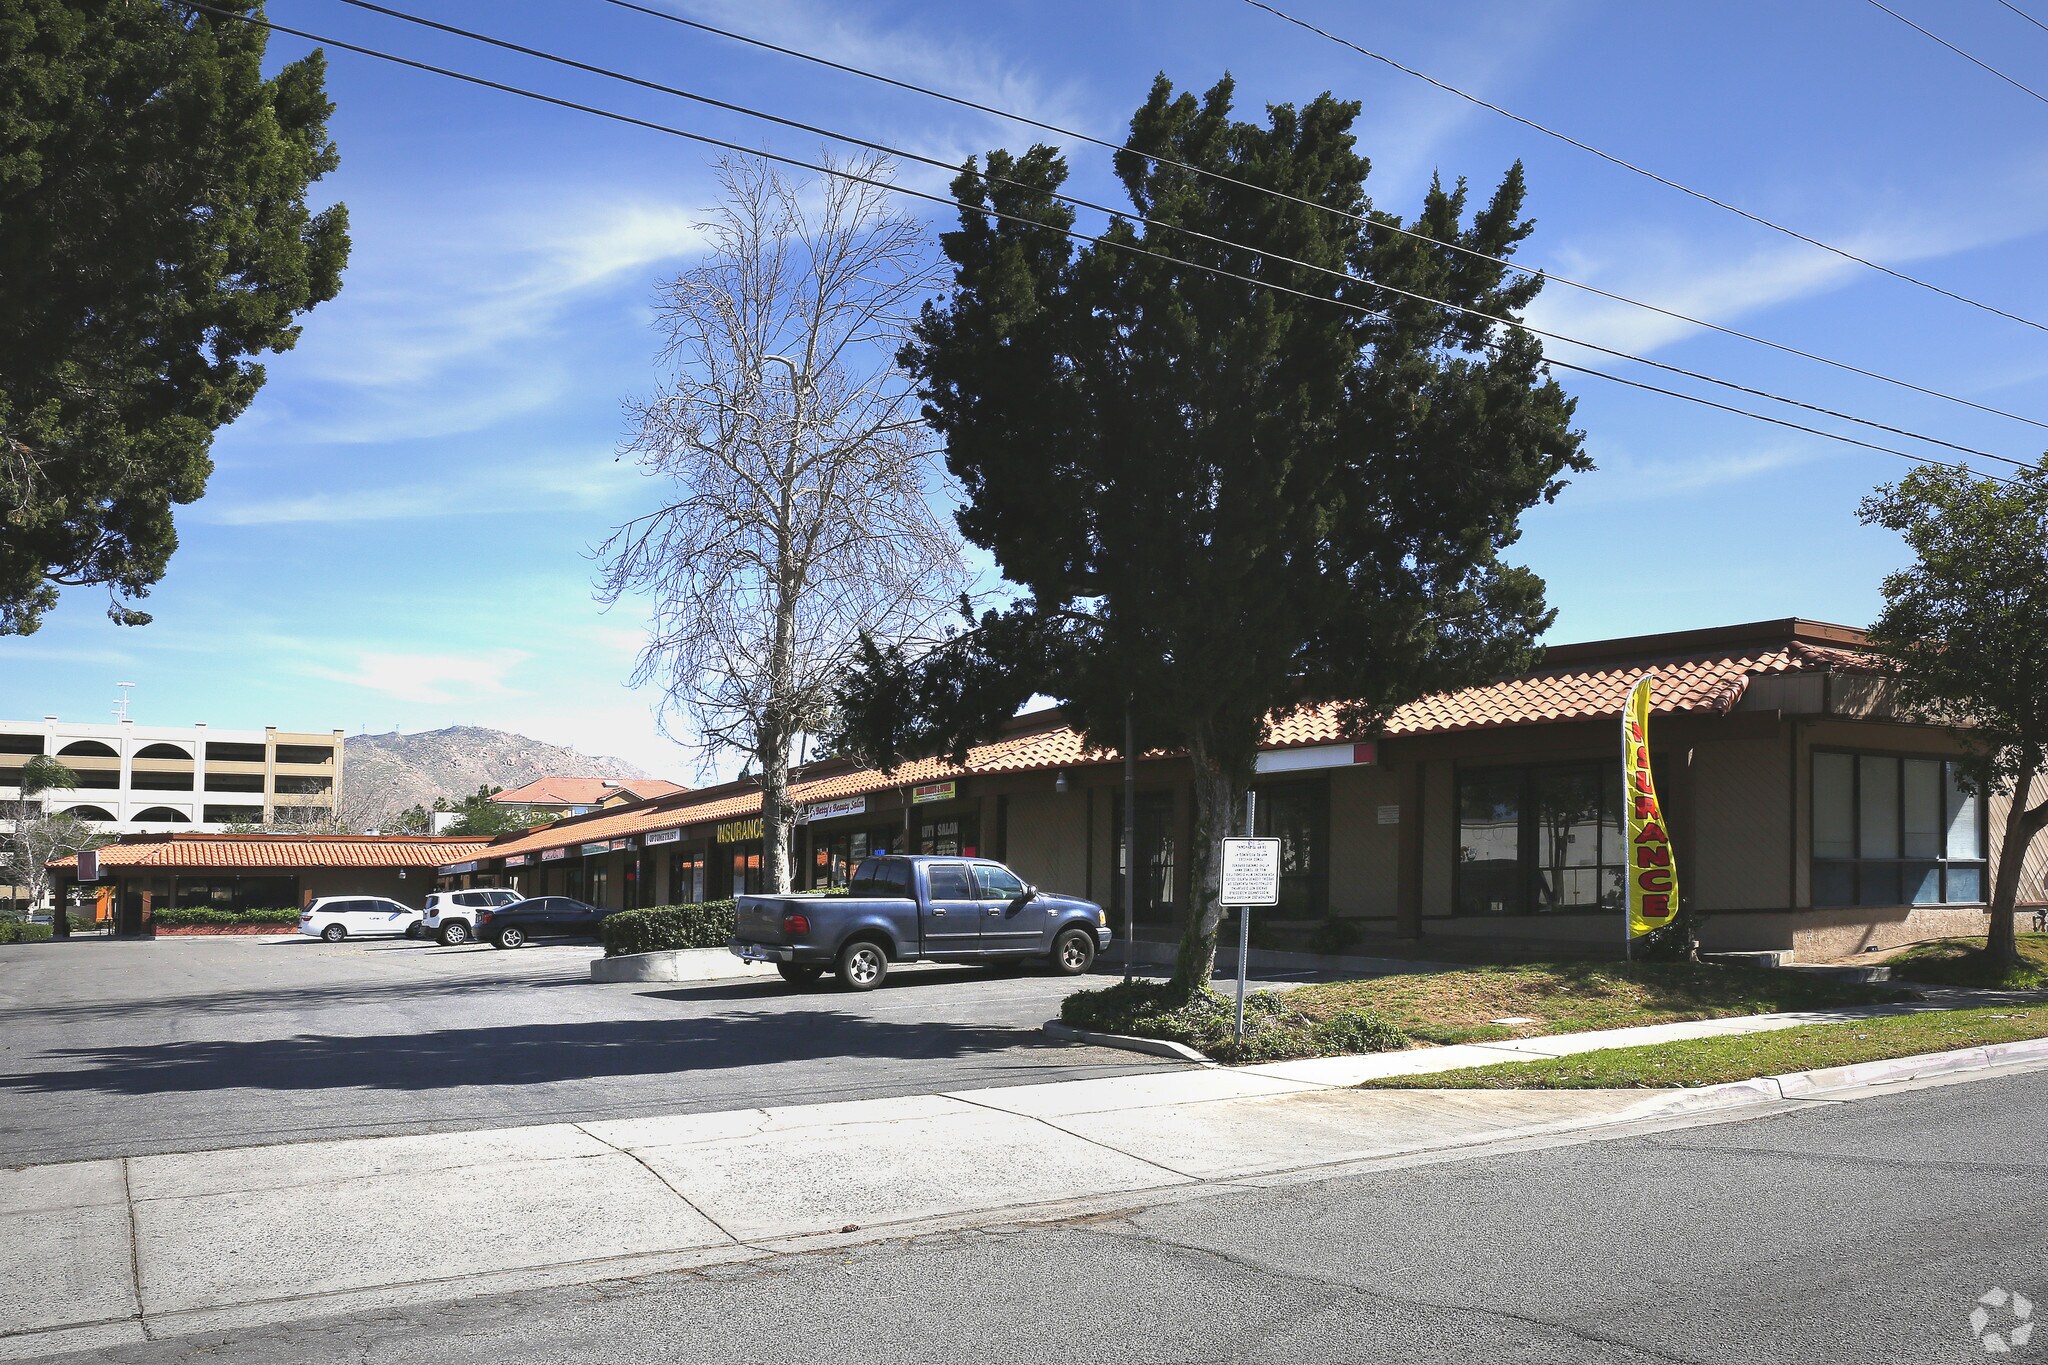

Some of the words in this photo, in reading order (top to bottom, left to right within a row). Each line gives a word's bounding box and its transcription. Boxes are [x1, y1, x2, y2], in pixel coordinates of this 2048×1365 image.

[833, 802, 850, 813] Beauty
[850, 798, 865, 810] Salon
[717, 817, 764, 843] INSURANCE
[937, 822, 959, 836] SALON
